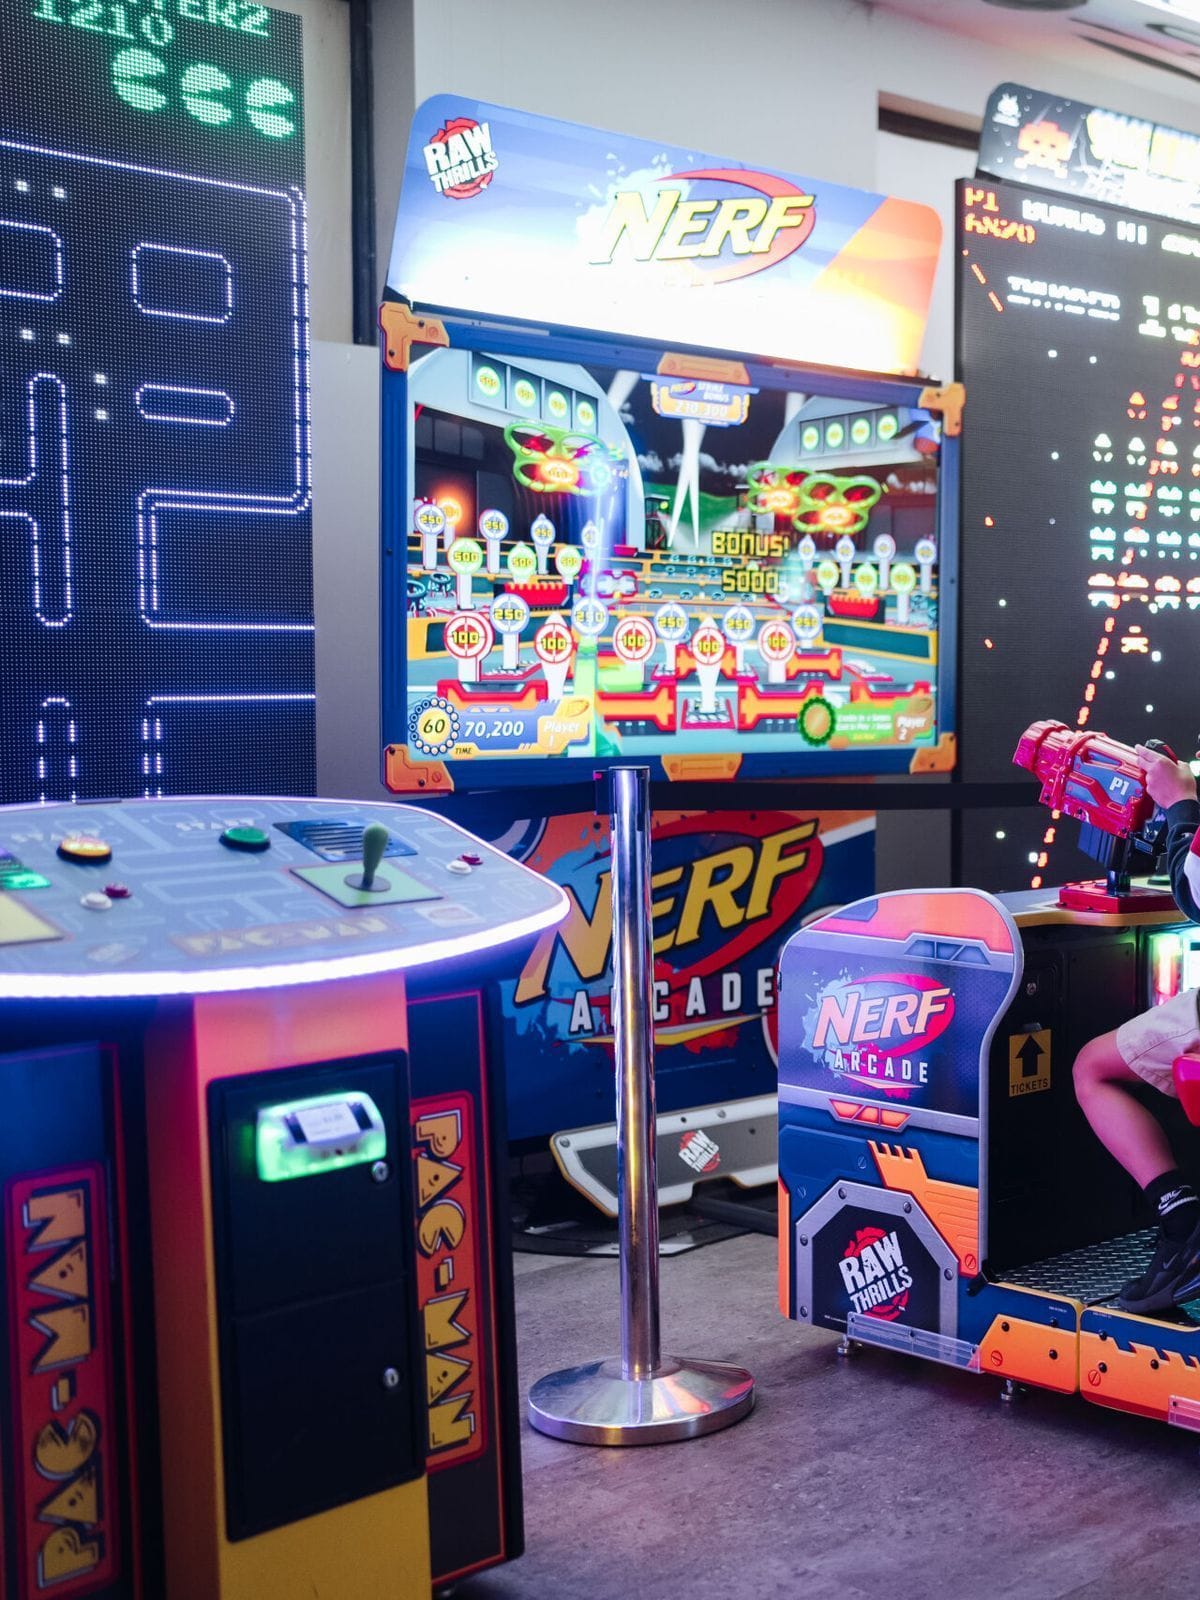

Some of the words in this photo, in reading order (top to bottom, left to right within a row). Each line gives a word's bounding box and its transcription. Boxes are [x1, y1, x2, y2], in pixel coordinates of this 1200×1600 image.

[423, 122, 492, 175] RAW
[430, 151, 499, 192] THRILLS
[588, 189, 816, 264] NERF
[419, 514, 443, 525] 250
[712, 530, 790, 558] BONUS!
[453, 550, 479, 562] 500
[511, 556, 533, 568] 500
[722, 569, 780, 595] 5000
[493, 608, 525, 621] 250
[575, 610, 604, 622] 250
[657, 616, 685, 627] 250
[795, 616, 818, 627] 250
[726, 618, 750, 630] 250
[451, 630, 480, 644] 100
[540, 637, 567, 650] 100
[622, 634, 646, 647] 100
[698, 640, 720, 652] 100
[767, 636, 788, 648] 100
[423, 718, 446, 734] 60
[463, 720, 525, 739] 70,200
[1109, 776, 1130, 796] P1
[568, 967, 776, 1034] ACADE
[812, 987, 951, 1048] NERF
[834, 1048, 928, 1083] ARCADE
[1010, 1078, 1048, 1095] TICKETS
[838, 1230, 904, 1295] RAW
[414, 1109, 477, 1450] PAC-MAN
[850, 1265, 913, 1314] THRILLS
[23, 1187, 99, 1588] PAC-MAN
